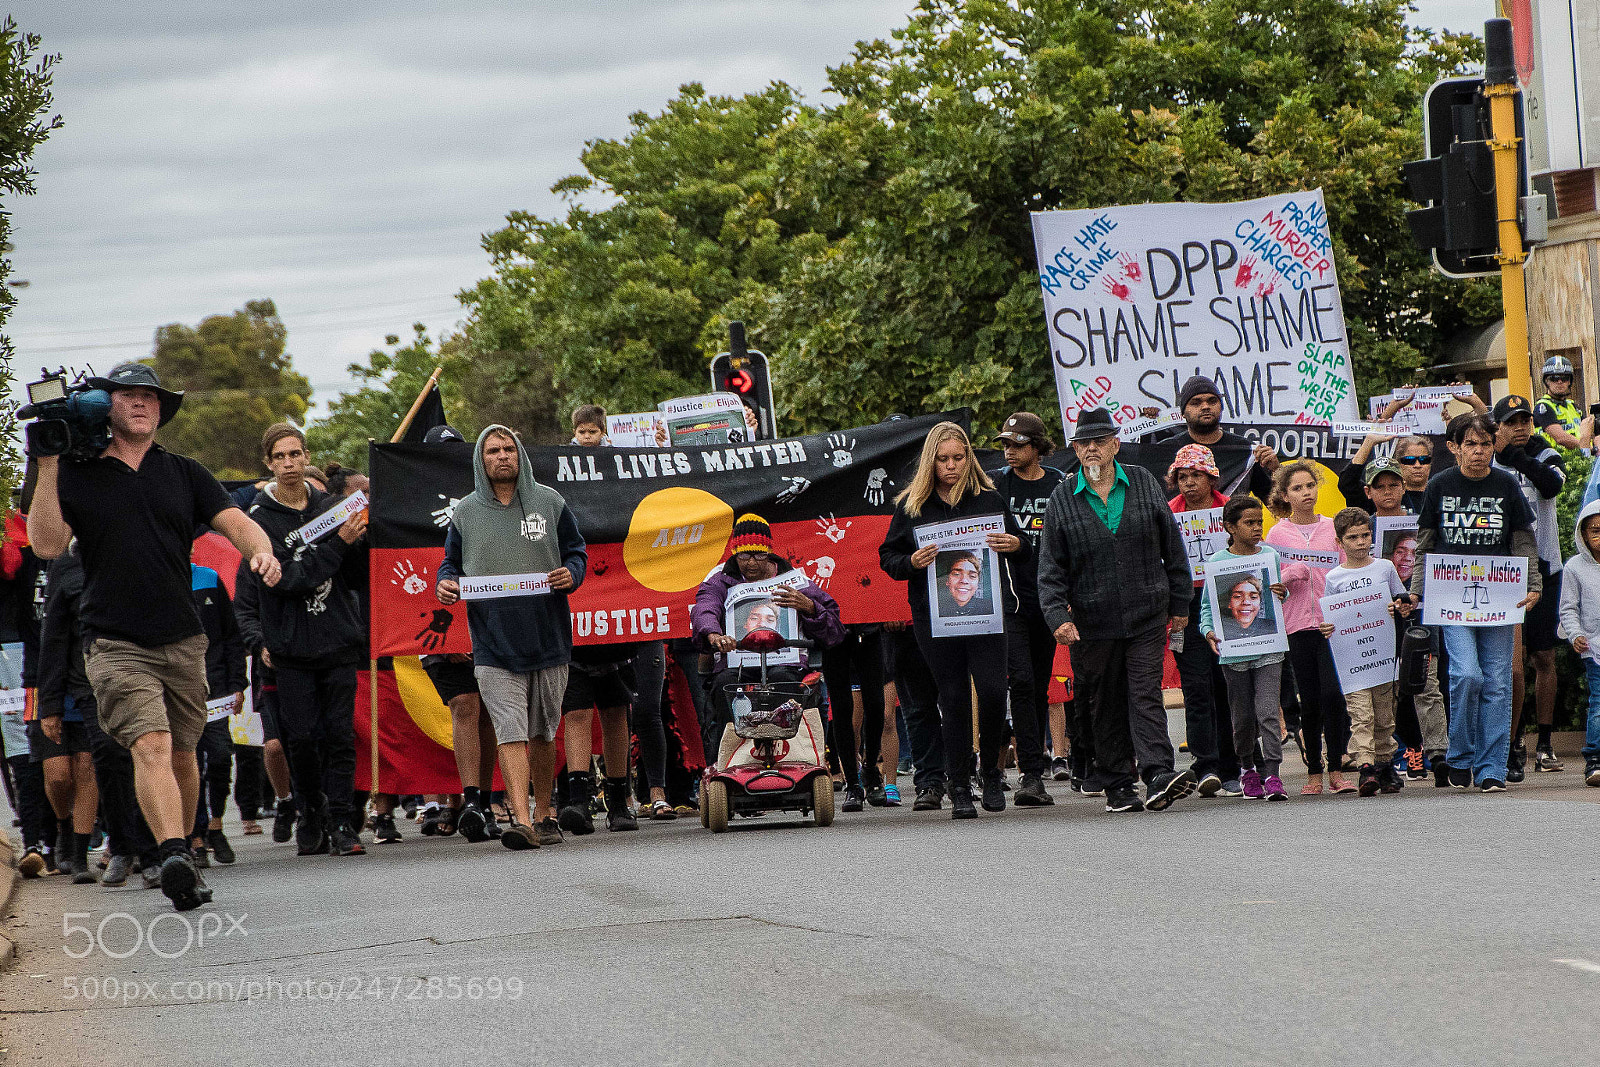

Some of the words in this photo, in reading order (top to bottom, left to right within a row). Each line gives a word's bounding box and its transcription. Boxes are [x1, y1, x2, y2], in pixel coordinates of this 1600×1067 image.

[1305, 200, 1328, 230] NO
[1281, 201, 1331, 257] PROPER
[1040, 246, 1081, 296] RACE
[1074, 213, 1118, 248] HATE
[1235, 219, 1312, 290] CHARGES
[1260, 210, 1330, 280] MURDER
[1070, 241, 1119, 291] CRIME
[1146, 239, 1238, 300] DPP
[1053, 300, 1198, 369] SHAME
[1209, 283, 1343, 358] SHAME
[1304, 343, 1346, 369] SLAP
[1069, 378, 1087, 396] A
[1297, 360, 1317, 381] ON
[1325, 370, 1350, 395] THE
[1065, 376, 1112, 423] CHILD
[1299, 378, 1346, 406] WRIST
[667, 397, 740, 414] #JusticeForElijah
[1305, 397, 1337, 421] FOR
[612, 416, 638, 434] where's
[639, 416, 650, 432] the
[1335, 425, 1411, 435] #JusticeForElijah
[557, 455, 603, 482] ALL
[613, 451, 692, 479] LIVES
[701, 441, 807, 473] MATTER
[1010, 496, 1051, 514] LAC
[1442, 495, 1504, 513] BLACK
[303, 496, 364, 540] #JusticeForElijah
[1191, 514, 1207, 536] the
[1443, 512, 1503, 528] LIVES
[651, 523, 705, 548] AND
[918, 532, 938, 543] WHERE
[938, 531, 944, 539] IS
[944, 529, 954, 538] THE
[954, 521, 1003, 536] JUSTICE?
[1443, 527, 1503, 545] MATTER
[1280, 551, 1290, 559] THE
[1290, 553, 1338, 564] JUSTICE?
[1433, 559, 1468, 581] where's
[1470, 559, 1486, 582] the
[1487, 560, 1522, 584] Justice
[462, 579, 548, 594] #JusticeForElijah
[1329, 599, 1353, 612] DON'T
[1352, 592, 1383, 605] RELEASE
[1356, 611, 1363, 619] A
[1440, 608, 1463, 621] FOR
[1340, 624, 1361, 636] CHILD
[1361, 618, 1385, 633] KILLER
[1356, 635, 1375, 646] INTO
[1361, 648, 1378, 659] OUR
[1349, 657, 1396, 675] COMMUNITY
